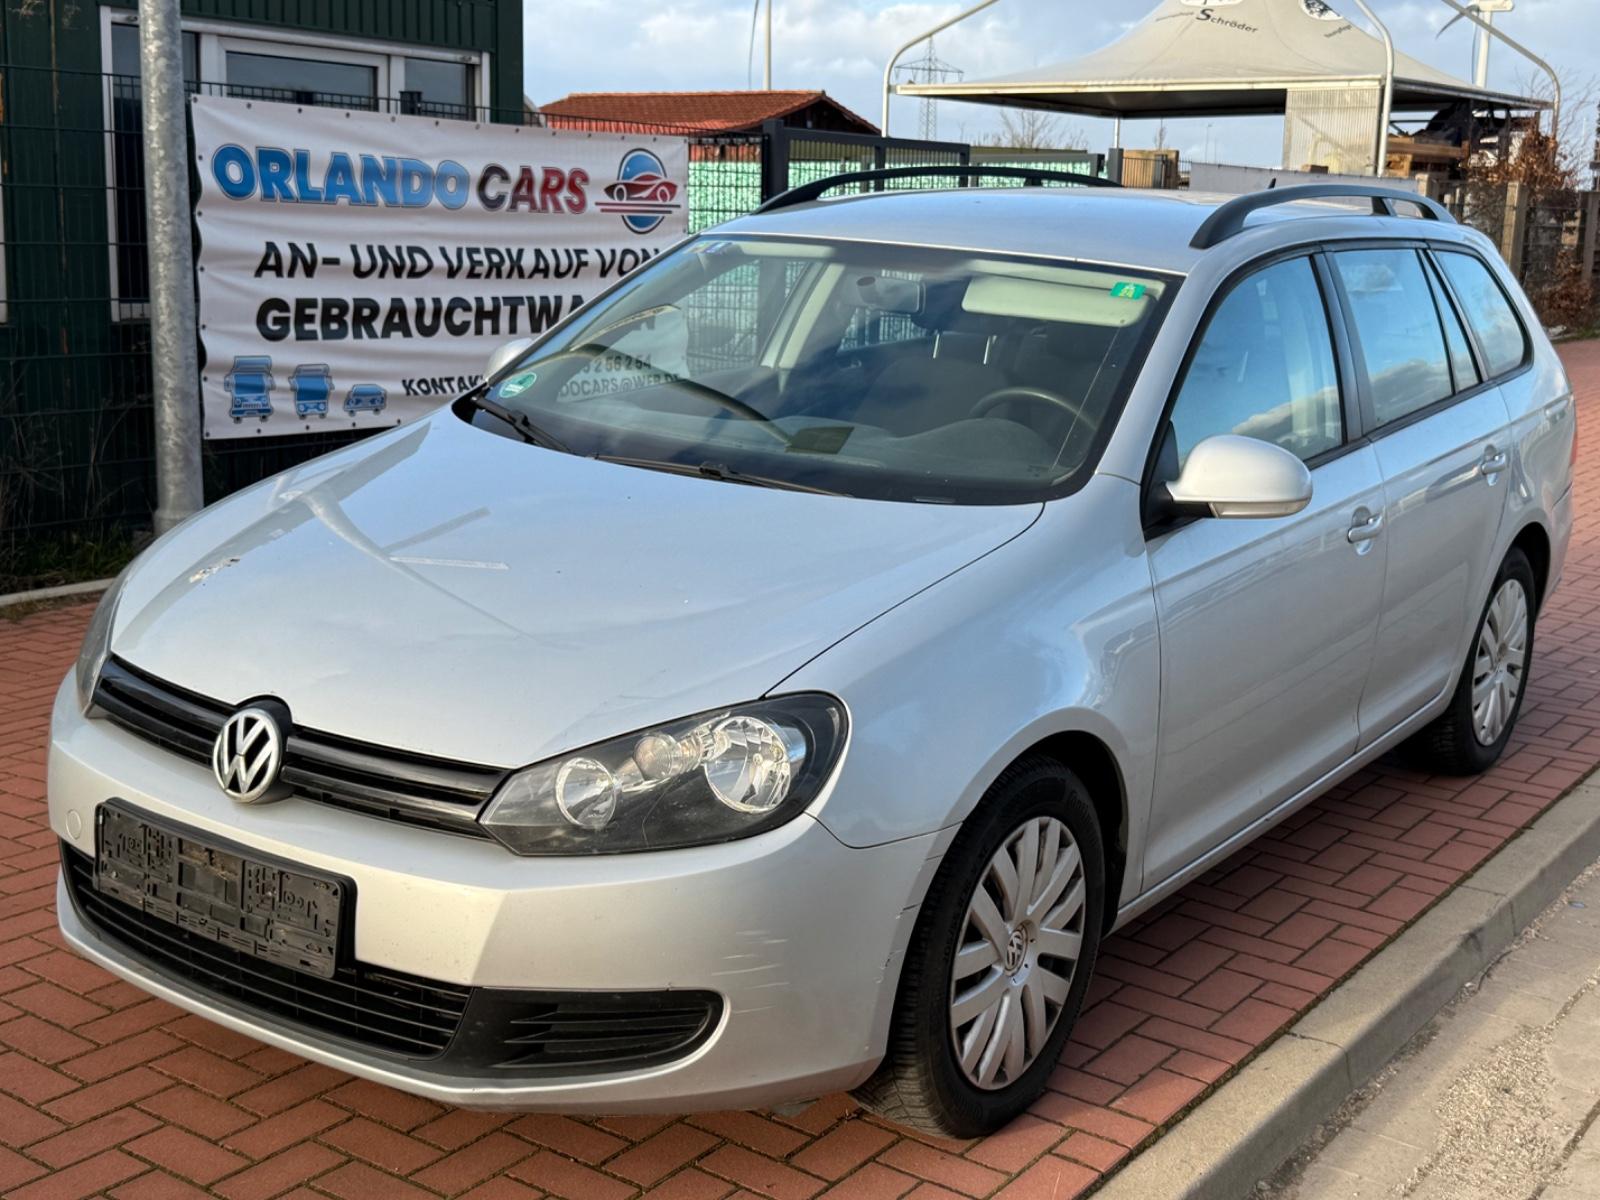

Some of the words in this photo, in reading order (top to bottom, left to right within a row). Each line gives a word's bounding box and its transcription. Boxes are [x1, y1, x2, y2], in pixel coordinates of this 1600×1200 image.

[1196, 8, 1258, 33] Schröder
[211, 143, 471, 210] ORLANDO
[477, 163, 589, 214] CARS
[254, 241, 340, 278] AN-
[350, 244, 434, 279] UND
[438, 246, 588, 279] VERKAUF
[401, 375, 483, 396] KONTAK
